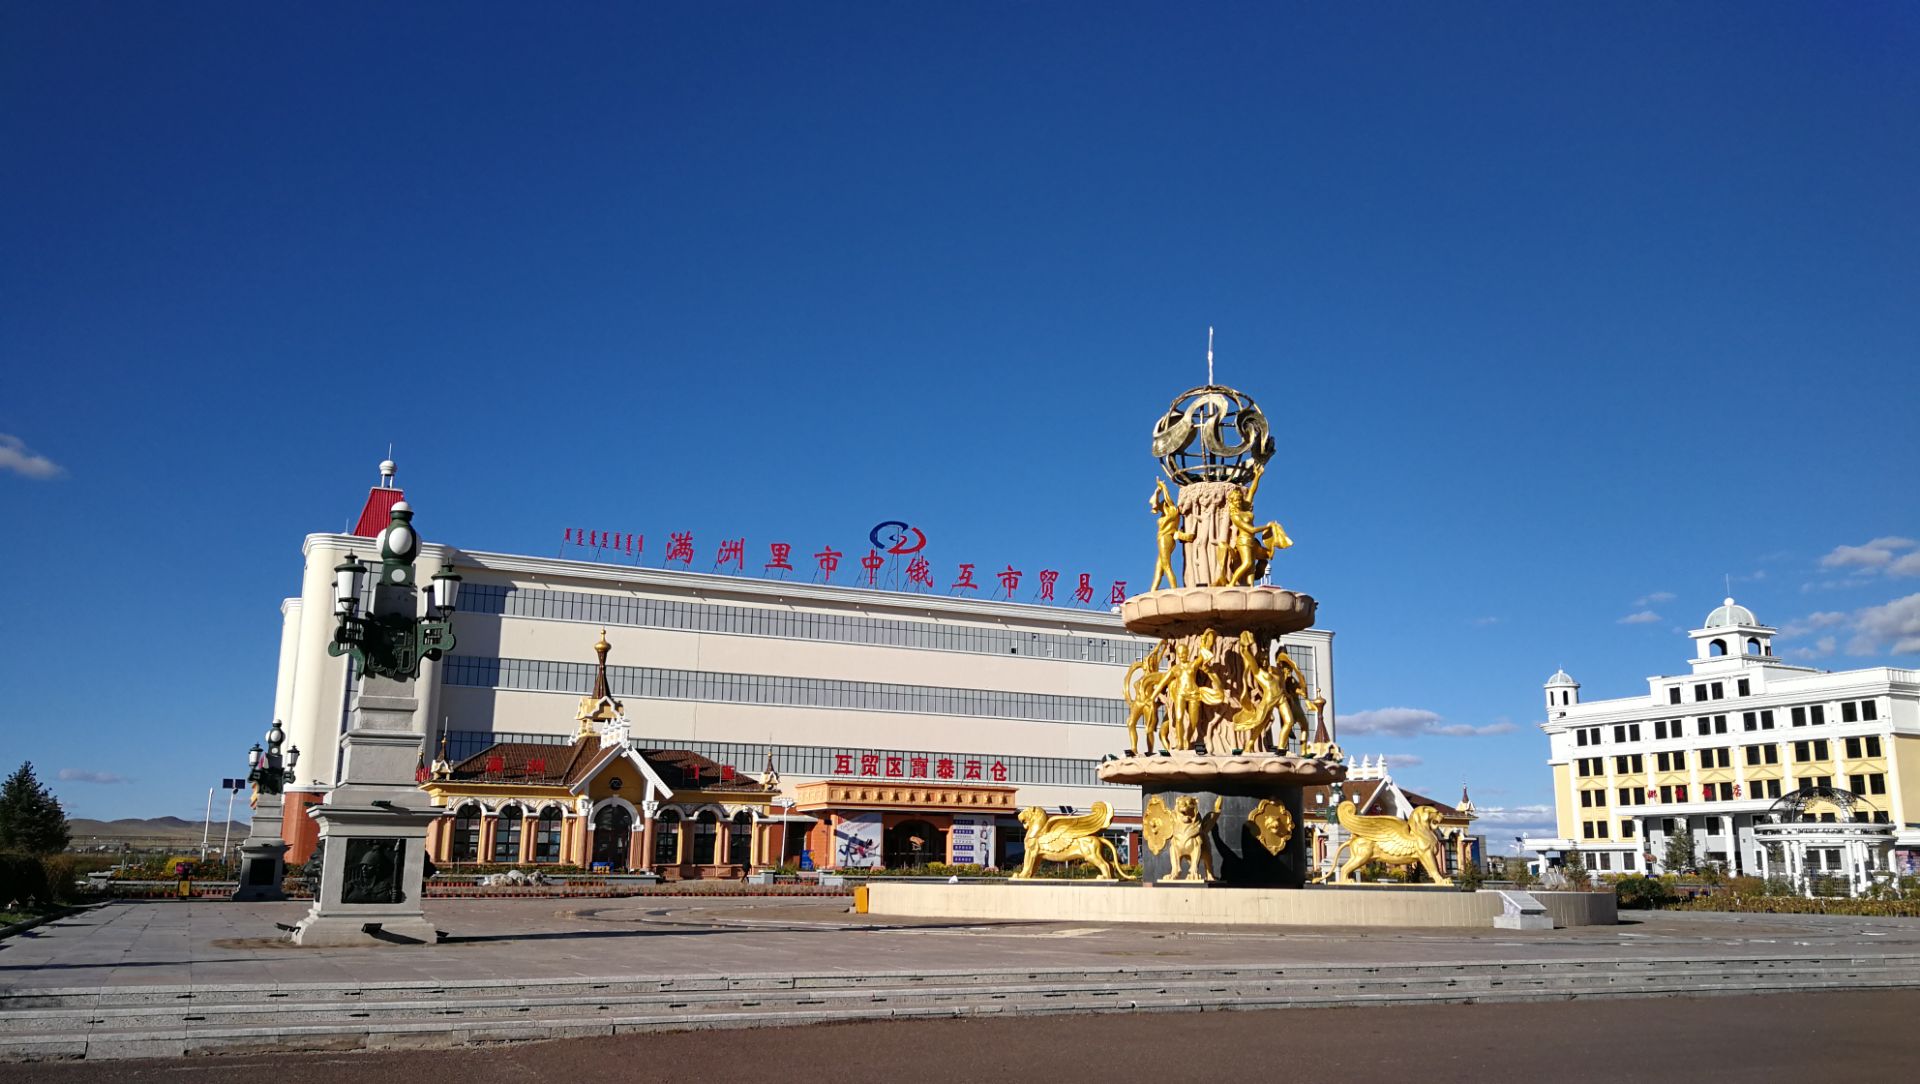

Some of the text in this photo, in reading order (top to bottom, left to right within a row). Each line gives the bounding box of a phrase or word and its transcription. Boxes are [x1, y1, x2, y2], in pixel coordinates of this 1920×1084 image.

[666, 531, 1127, 605] 满洲里市中俄互市贸易区
